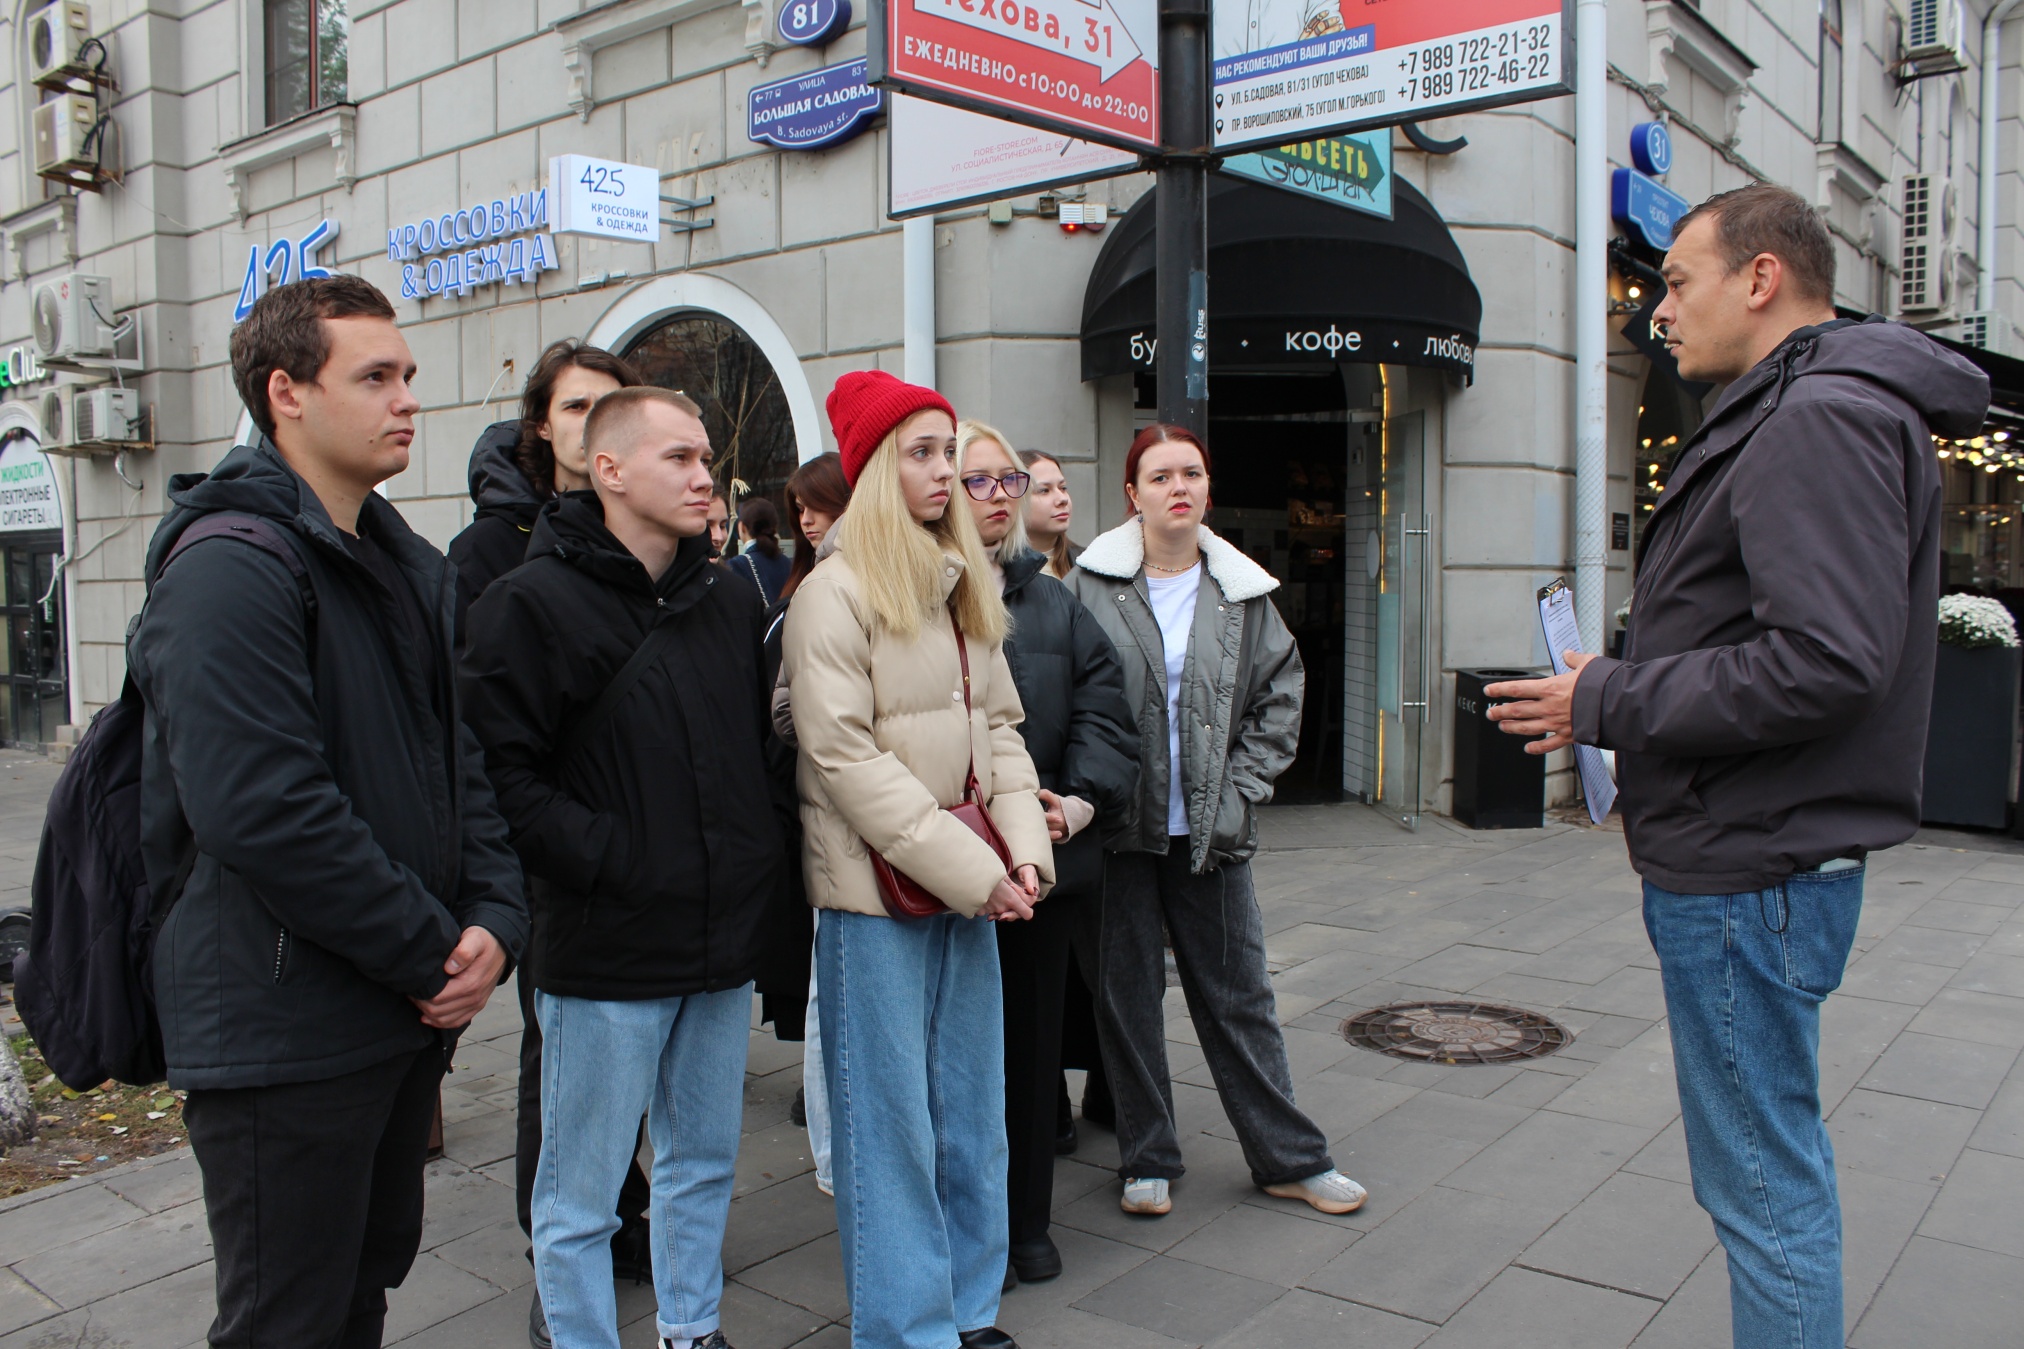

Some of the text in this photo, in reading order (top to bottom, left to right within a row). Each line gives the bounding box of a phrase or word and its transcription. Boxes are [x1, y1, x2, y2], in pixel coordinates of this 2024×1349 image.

[792, 1, 818, 29] 81
[945, 0, 1112, 58] ехова, 31
[1215, 33, 1368, 80] НАС РЕКОМЕНДУЮТ ВАШИ ДРУЗЬЯ!
[1398, 24, 1550, 75] +7 989 722-21-32
[798, 76, 826, 91] УЛИЦА
[851, 66, 862, 76] 83
[904, 35, 1149, 123] ЕЖЕДНЕВНО с 10:00 до 22:00
[1231, 92, 1243, 106] УЛ.
[1287, 78, 1311, 93] 81/31
[1336, 65, 1369, 83] ЧЕХОВА)
[1398, 53, 1550, 102] +7 989 722-46-22
[754, 84, 875, 125] БОЛЬШАЯ САДОВАЯ
[764, 91, 773, 99] 77
[777, 112, 848, 139] B. Sadovaya st.
[1231, 118, 1243, 132] ПР.
[1243, 103, 1304, 129] ВОРОШИЛОВСКИЙ,
[1306, 103, 1315, 118] 75
[951, 163, 963, 174] УЛ.
[963, 146, 1044, 171] СОЦИАЛИСТИЧЕСКАЯ,
[1054, 141, 1063, 150] 65
[973, 136, 1038, 157] FIORE-STORE.COM
[1654, 132, 1666, 162] 31
[580, 164, 625, 197] 42.5
[387, 187, 548, 261] КРОССОВКИ
[591, 202, 648, 220] КРОССОВКИ
[596, 216, 648, 234] & ОДЕЖДА
[401, 234, 548, 299] & ОДЕЖДА
[1286, 324, 1362, 358] кофе
[1, 461, 44, 482] ЖИДКОСТИ
[0, 485, 50, 505] ЛЕКТРОННЫЕ
[3, 508, 46, 526] СИГАРЕТЫ
